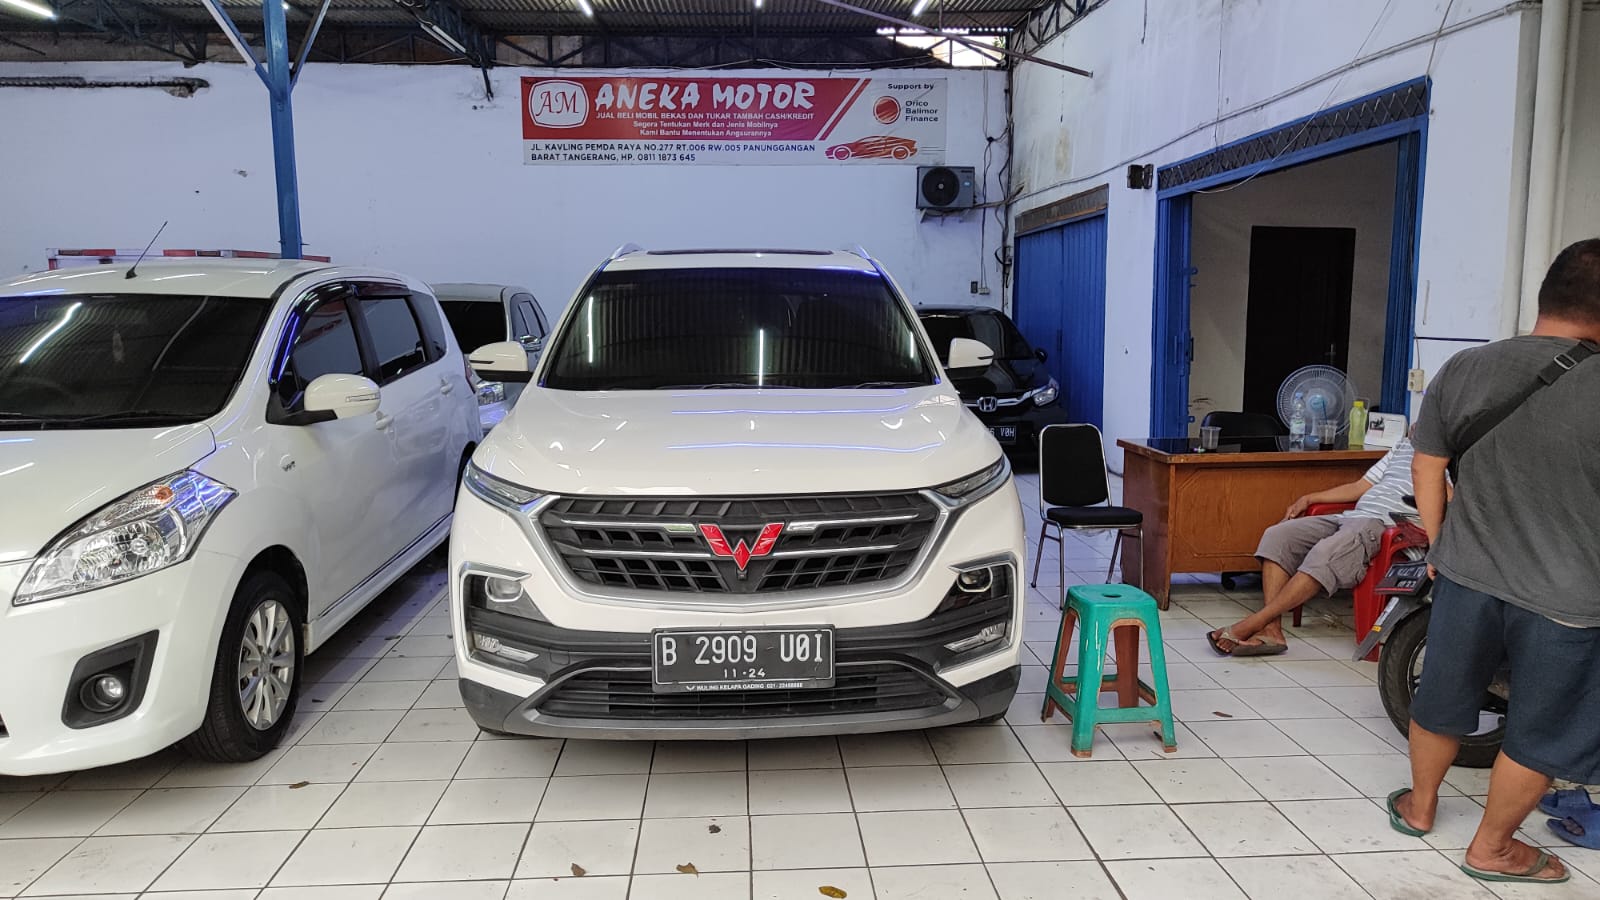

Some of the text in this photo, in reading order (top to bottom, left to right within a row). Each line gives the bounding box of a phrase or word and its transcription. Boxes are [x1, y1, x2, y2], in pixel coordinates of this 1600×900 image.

[923, 82, 934, 90] by
[594, 81, 815, 111] ANEKA MOTOR
[535, 90, 579, 116] AM
[905, 107, 938, 115] Balimor
[596, 112, 814, 120] JUAL BELI MOBIL BEKAS DAN TUKAR TAMBAH CASH/KREDIT
[633, 120, 778, 129] Segera Tentukan Merk dan Jenis Mobilnya
[640, 129, 658, 137] Kami
[660, 129, 680, 137] Bantu
[726, 129, 772, 138] Angsurannya
[545, 143, 583, 151] KAVLING
[586, 143, 615, 151] PEMDA
[618, 143, 641, 151] RAYA
[644, 143, 674, 152] NO.277
[676, 144, 706, 152] RT.006
[708, 144, 740, 152] RW.005
[743, 144, 815, 152] PANUNGGANGAN
[532, 153, 696, 162] BARAT TANGERANG, HP. 0811 1873 645
[661, 637, 677, 666] B
[694, 635, 757, 665] 2909
